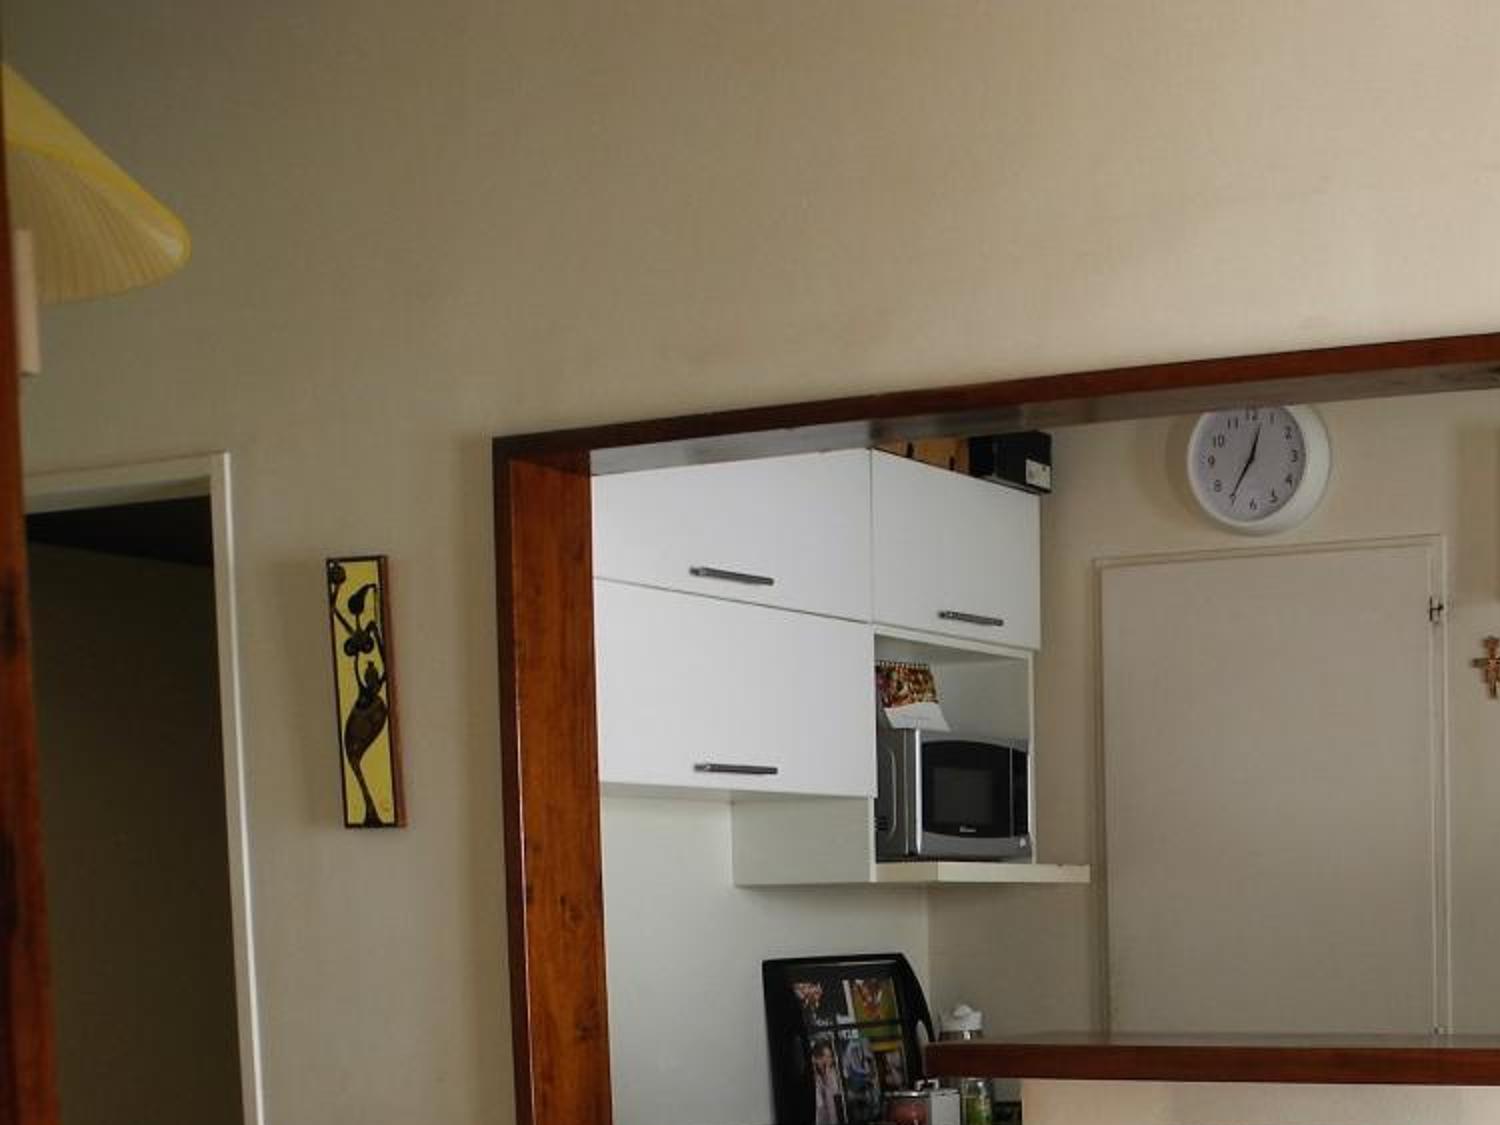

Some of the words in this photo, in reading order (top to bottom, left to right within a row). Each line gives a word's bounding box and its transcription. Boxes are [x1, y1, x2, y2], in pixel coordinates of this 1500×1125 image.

[1227, 417, 1239, 430] 11
[1284, 426, 1293, 440] 2
[1213, 434, 1225, 449] 10
[1208, 455, 1216, 468] 9
[1291, 449, 1298, 463] 3
[1214, 480, 1222, 492] 8
[1285, 474, 1293, 488] 4
[1271, 488, 1279, 503] 5
